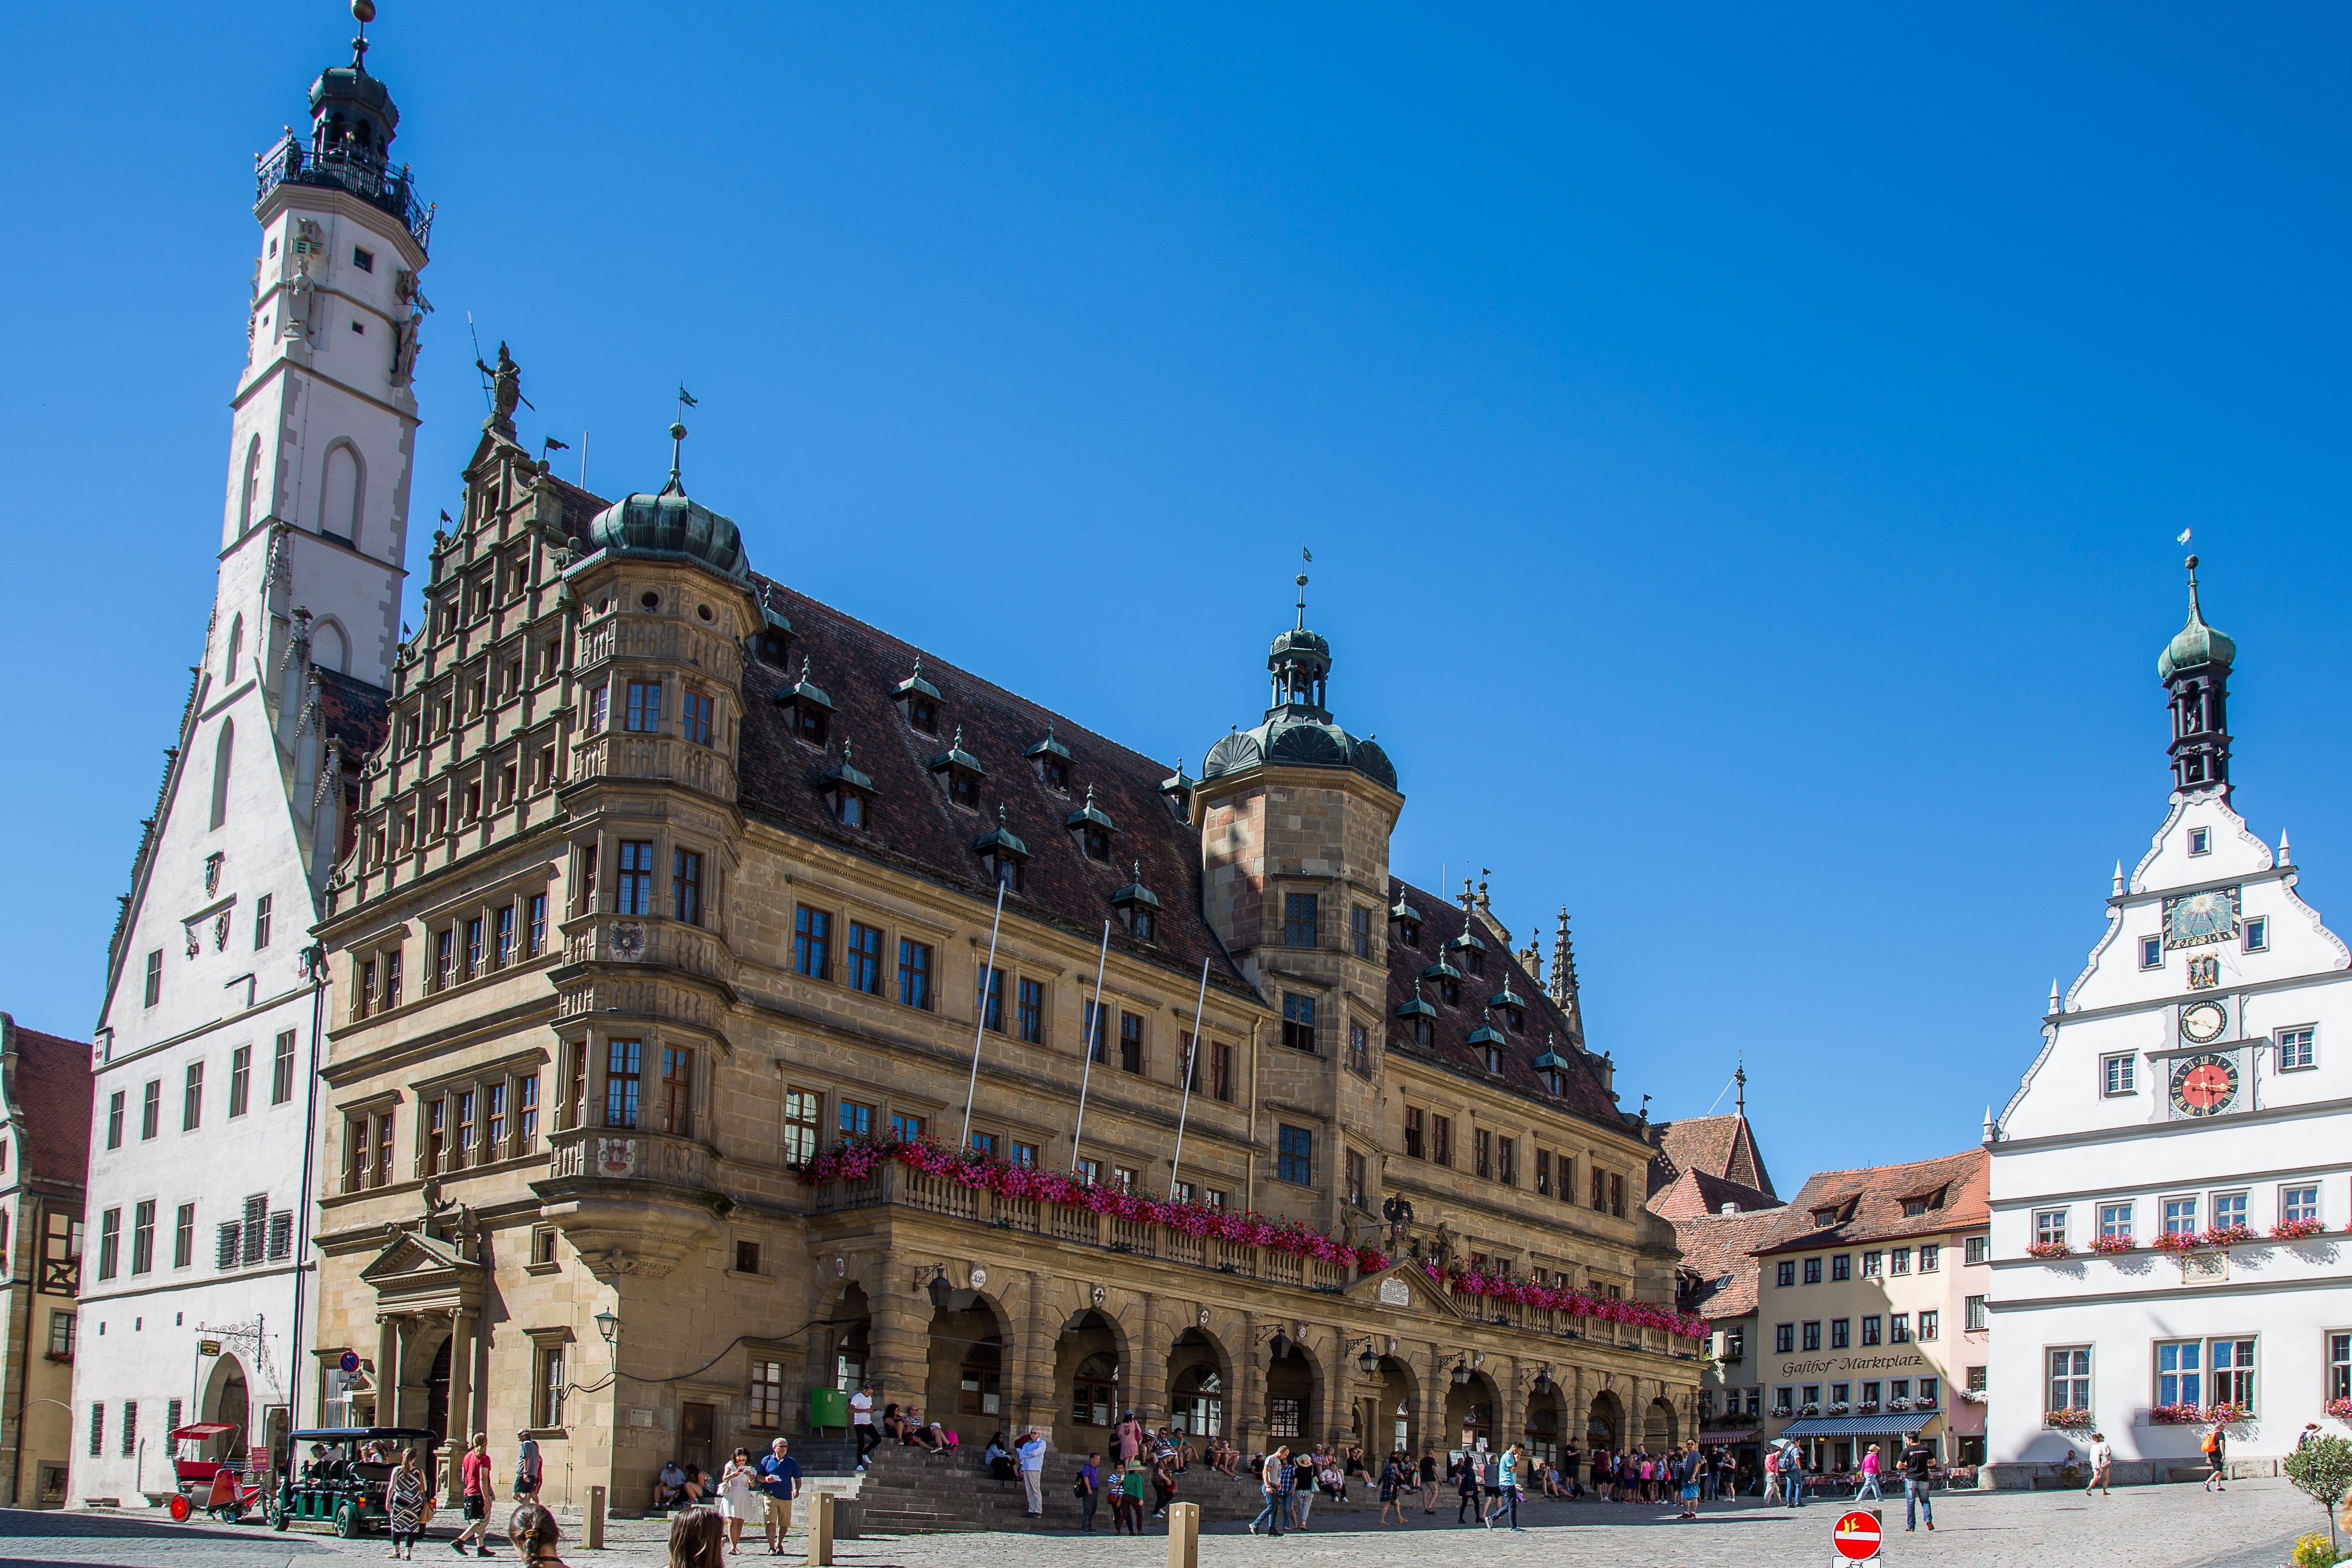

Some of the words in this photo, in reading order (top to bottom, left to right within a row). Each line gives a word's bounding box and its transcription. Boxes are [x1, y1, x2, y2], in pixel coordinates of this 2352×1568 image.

[2167, 898, 2176, 908] 17
[2200, 1055, 2208, 1065] XII
[2185, 1060, 2196, 1071] XI
[972, 1274, 985, 1284] 1681
[1839, 1355, 1923, 1370] Marktplatz
